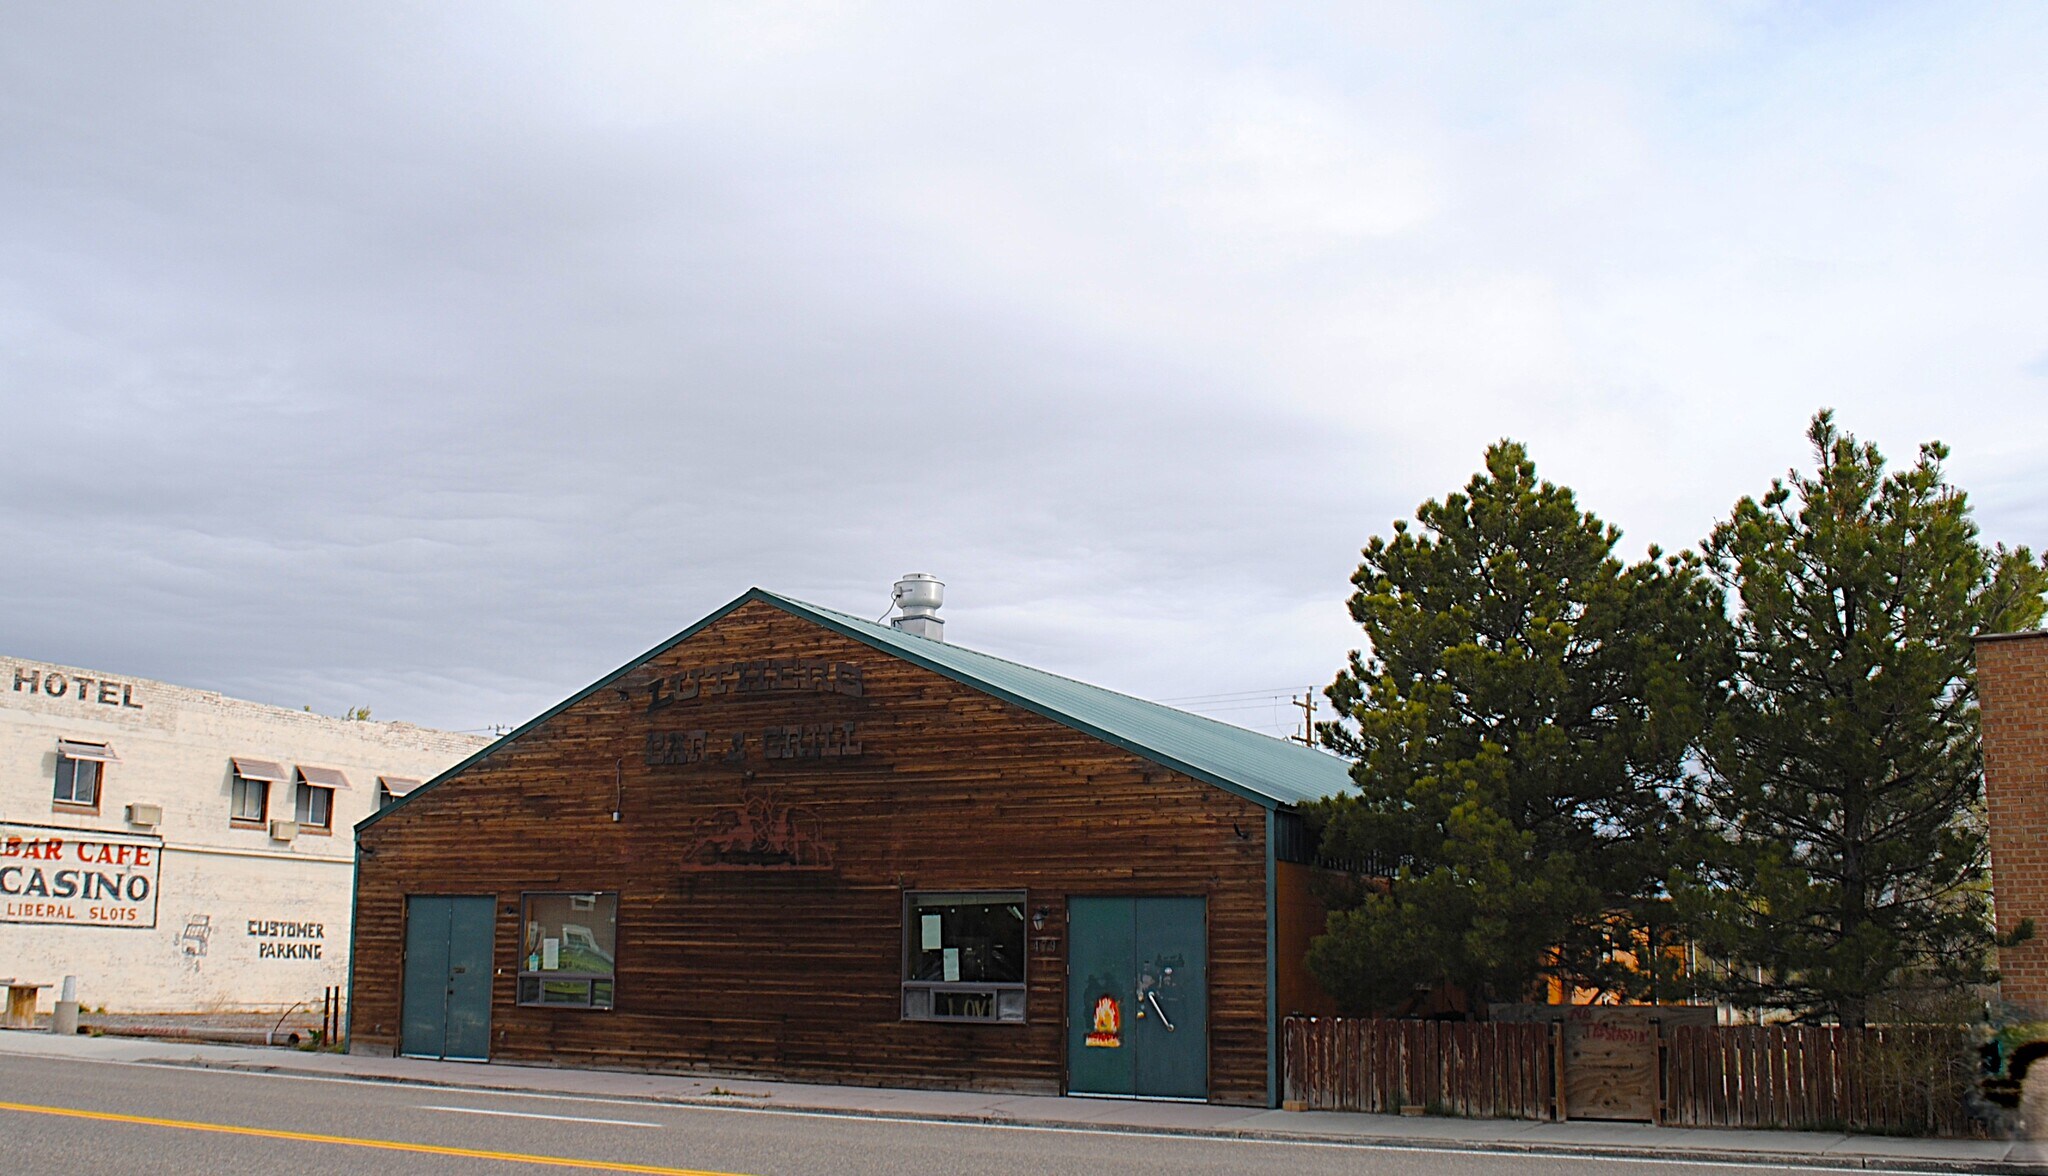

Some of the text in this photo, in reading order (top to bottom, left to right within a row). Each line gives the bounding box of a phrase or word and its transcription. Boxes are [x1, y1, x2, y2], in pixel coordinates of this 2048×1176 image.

[13, 667, 143, 709] HOTEL
[647, 659, 863, 714] LUTHERS
[763, 720, 863, 759] GRILL
[0, 836, 151, 866] BAR CAFE
[0, 866, 150, 902] CASINO
[7, 903, 137, 921] LIBERAL SLOTS
[247, 920, 325, 939] CUSTOMER
[259, 943, 322, 960] PARKING
[1569, 1007, 1591, 1020] NO
